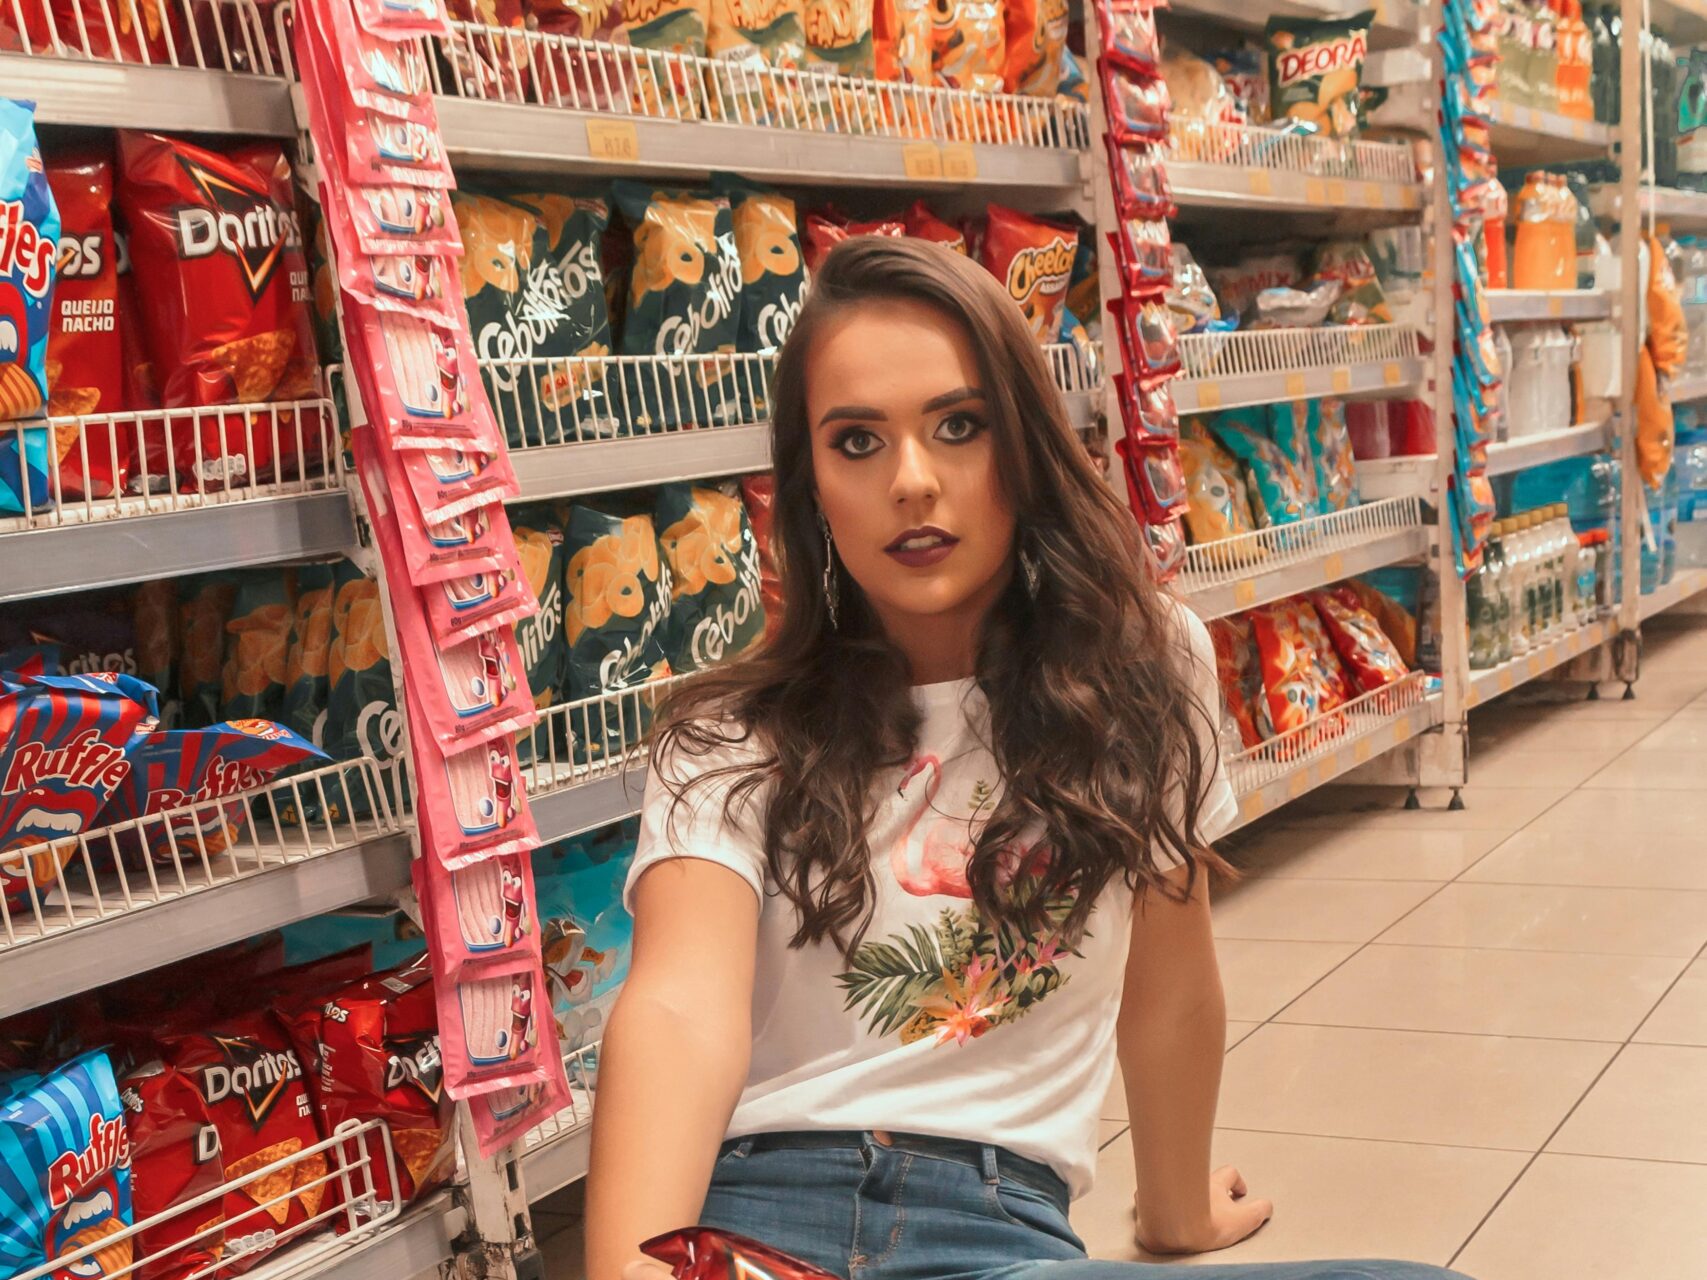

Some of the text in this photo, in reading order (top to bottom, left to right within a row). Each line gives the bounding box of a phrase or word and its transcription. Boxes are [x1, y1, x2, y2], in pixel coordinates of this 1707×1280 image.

[61, 299, 114, 316] QUEIJO
[62, 316, 115, 333] NACHO
[204, 1049, 302, 1104] Doritos
